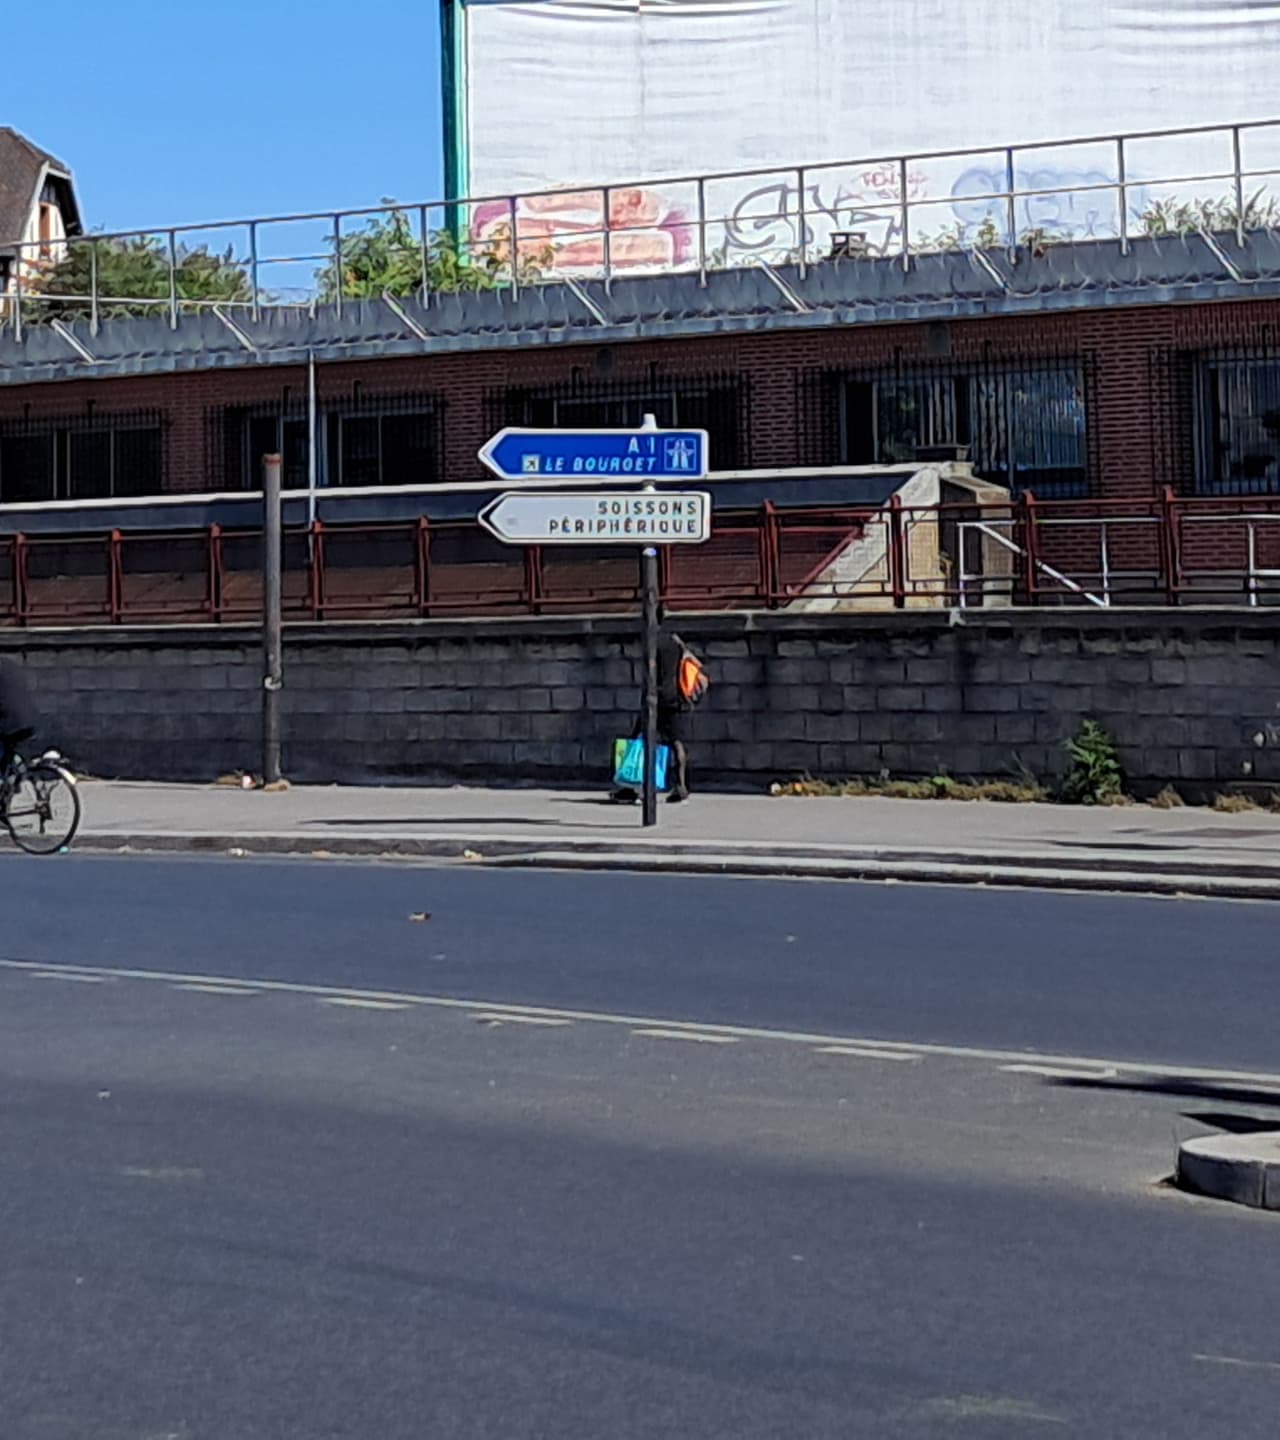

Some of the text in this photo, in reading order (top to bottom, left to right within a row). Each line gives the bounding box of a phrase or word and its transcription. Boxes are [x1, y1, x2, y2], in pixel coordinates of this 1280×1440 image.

[545, 456, 657, 472] LE BOURGET
[598, 500, 697, 515] SOISSONS
[549, 517, 697, 534] PÉRIPHÉRIQUE
